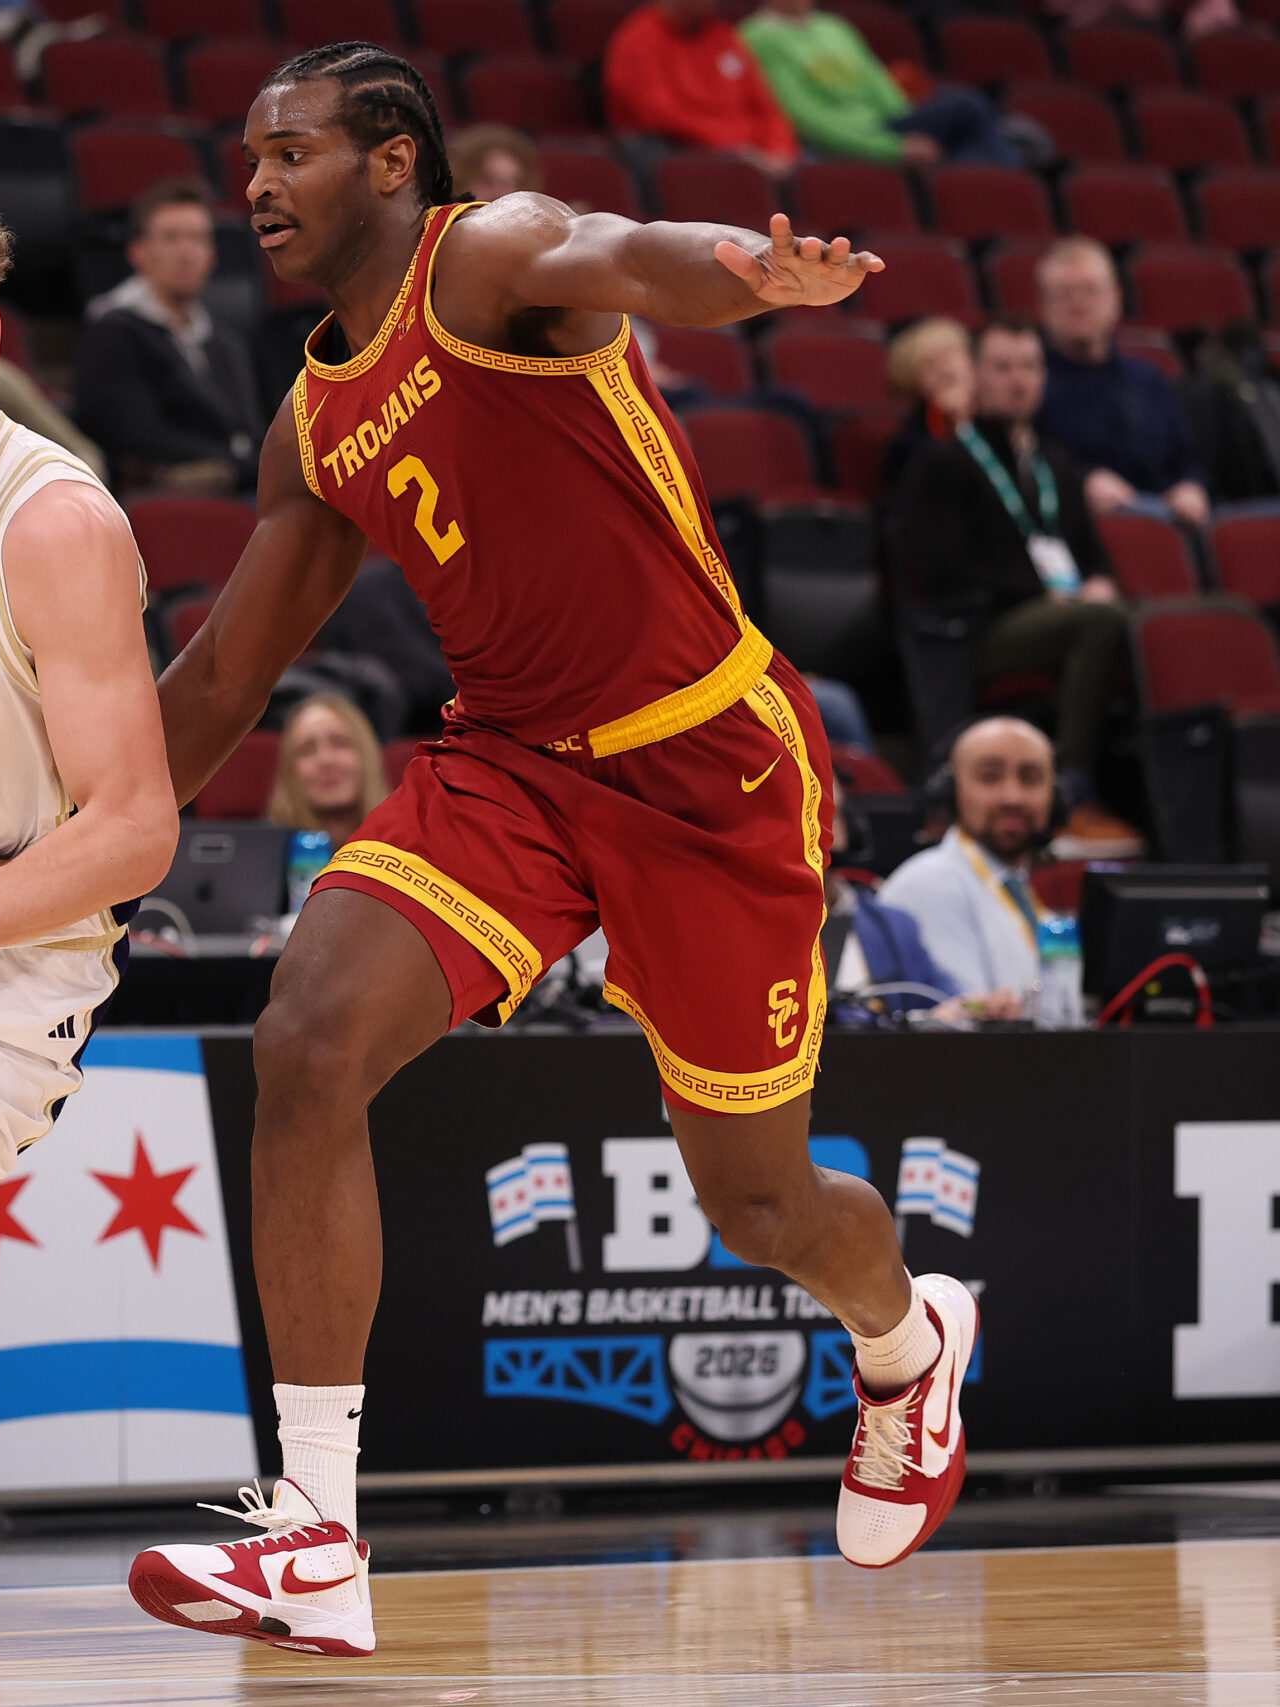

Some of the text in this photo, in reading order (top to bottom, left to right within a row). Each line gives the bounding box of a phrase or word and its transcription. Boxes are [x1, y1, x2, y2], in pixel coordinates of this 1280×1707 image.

[320, 354, 442, 488] TROJANS
[386, 454, 466, 566] 2
[481, 1290, 583, 1327] MEN'S
[585, 1284, 779, 1325] BASKETBALL
[694, 1345, 780, 1379] 2026
